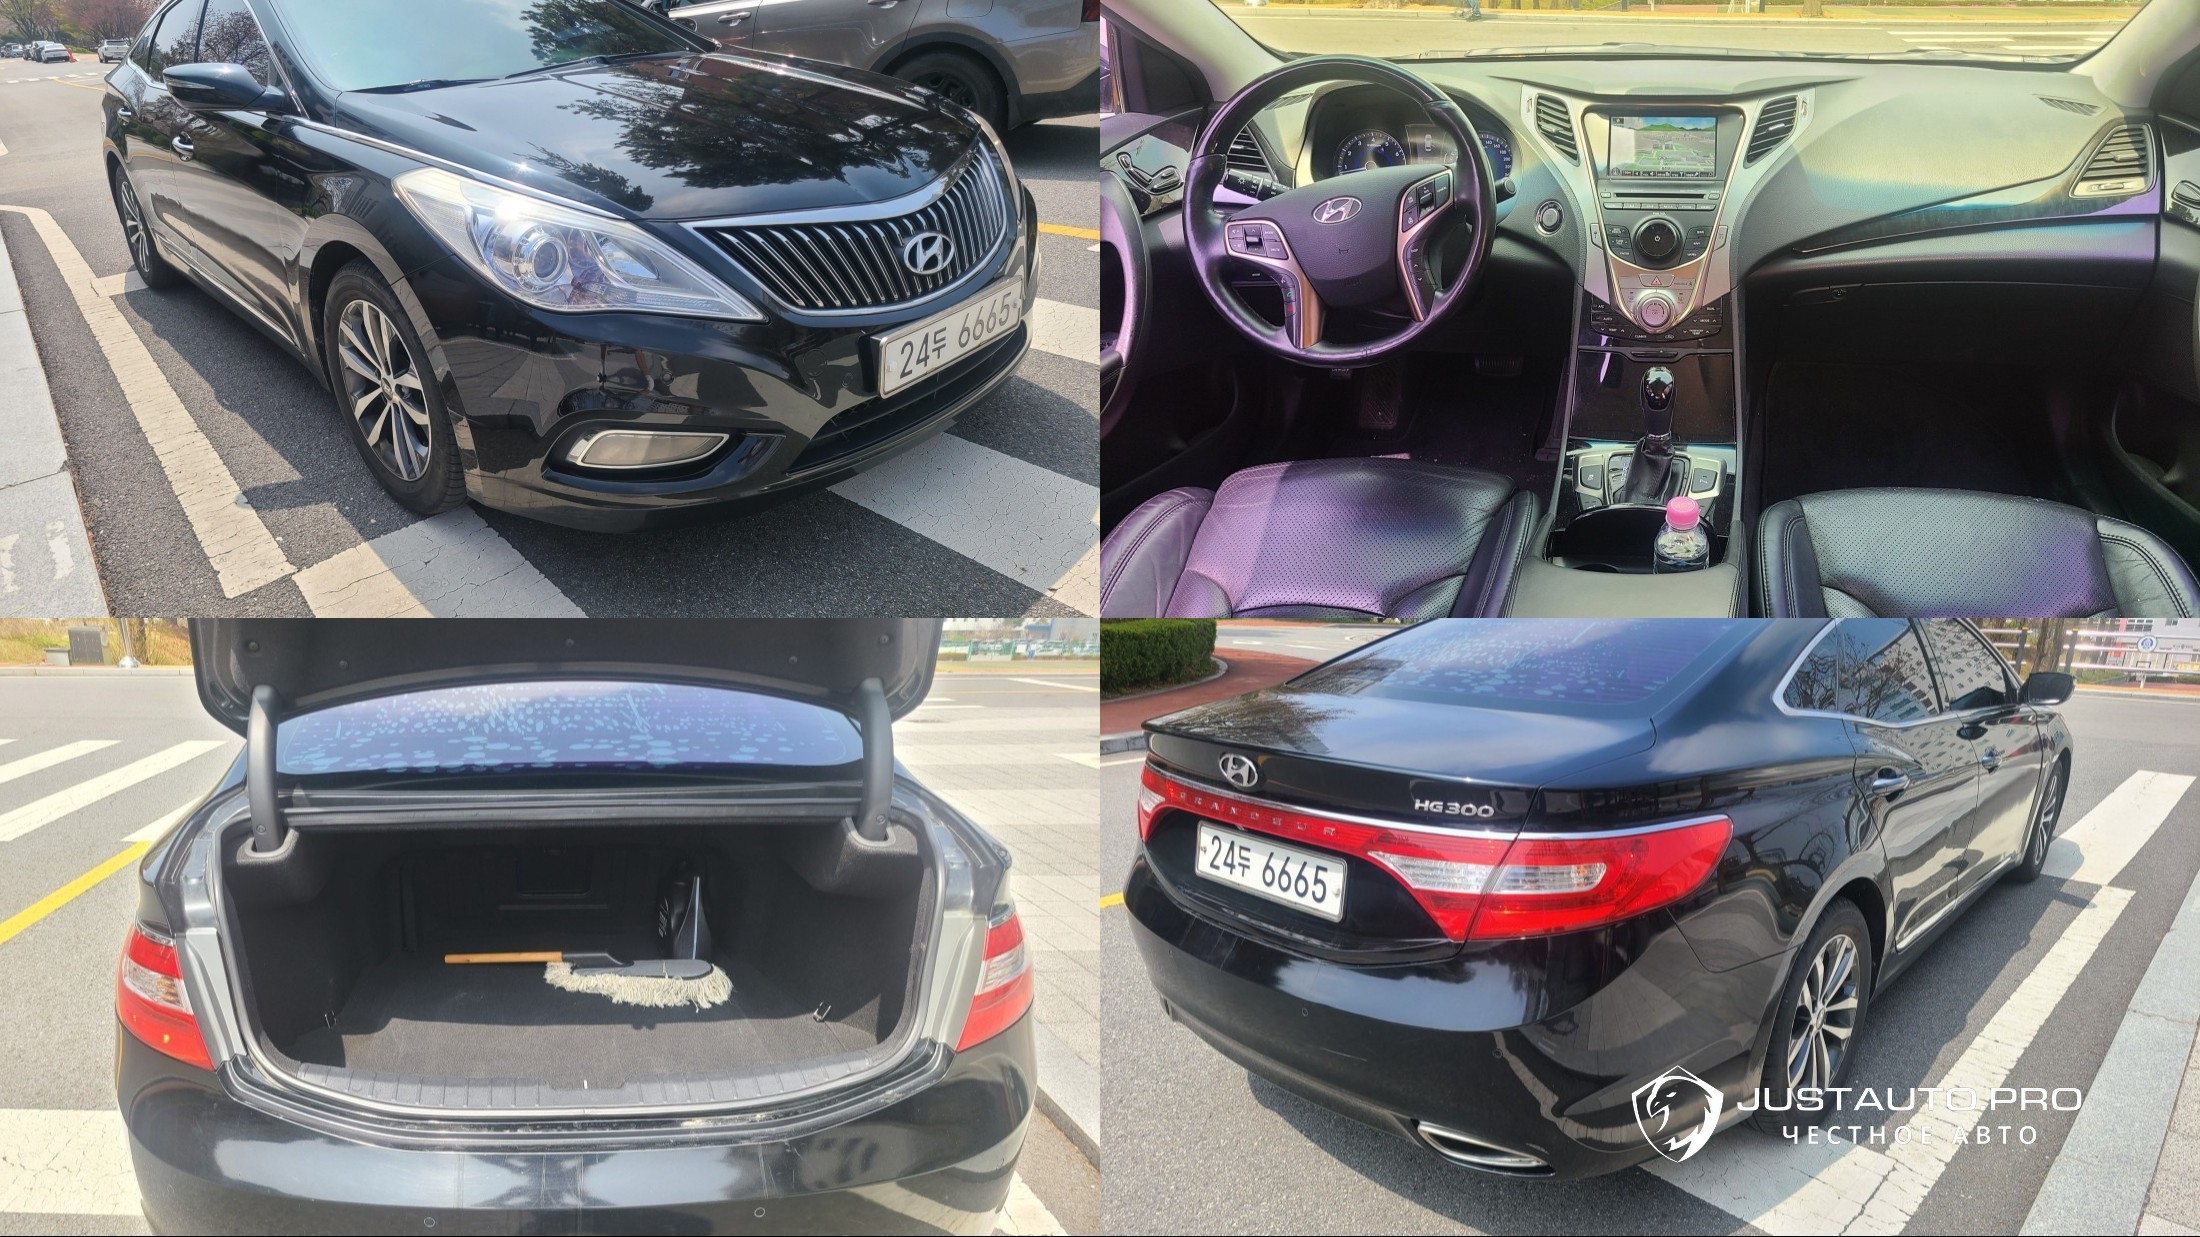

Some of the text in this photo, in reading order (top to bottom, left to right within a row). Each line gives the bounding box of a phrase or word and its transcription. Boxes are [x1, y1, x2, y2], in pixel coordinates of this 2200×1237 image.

[899, 291, 1012, 380] 24두 6665
[1209, 835, 1328, 904] 24두 6665
